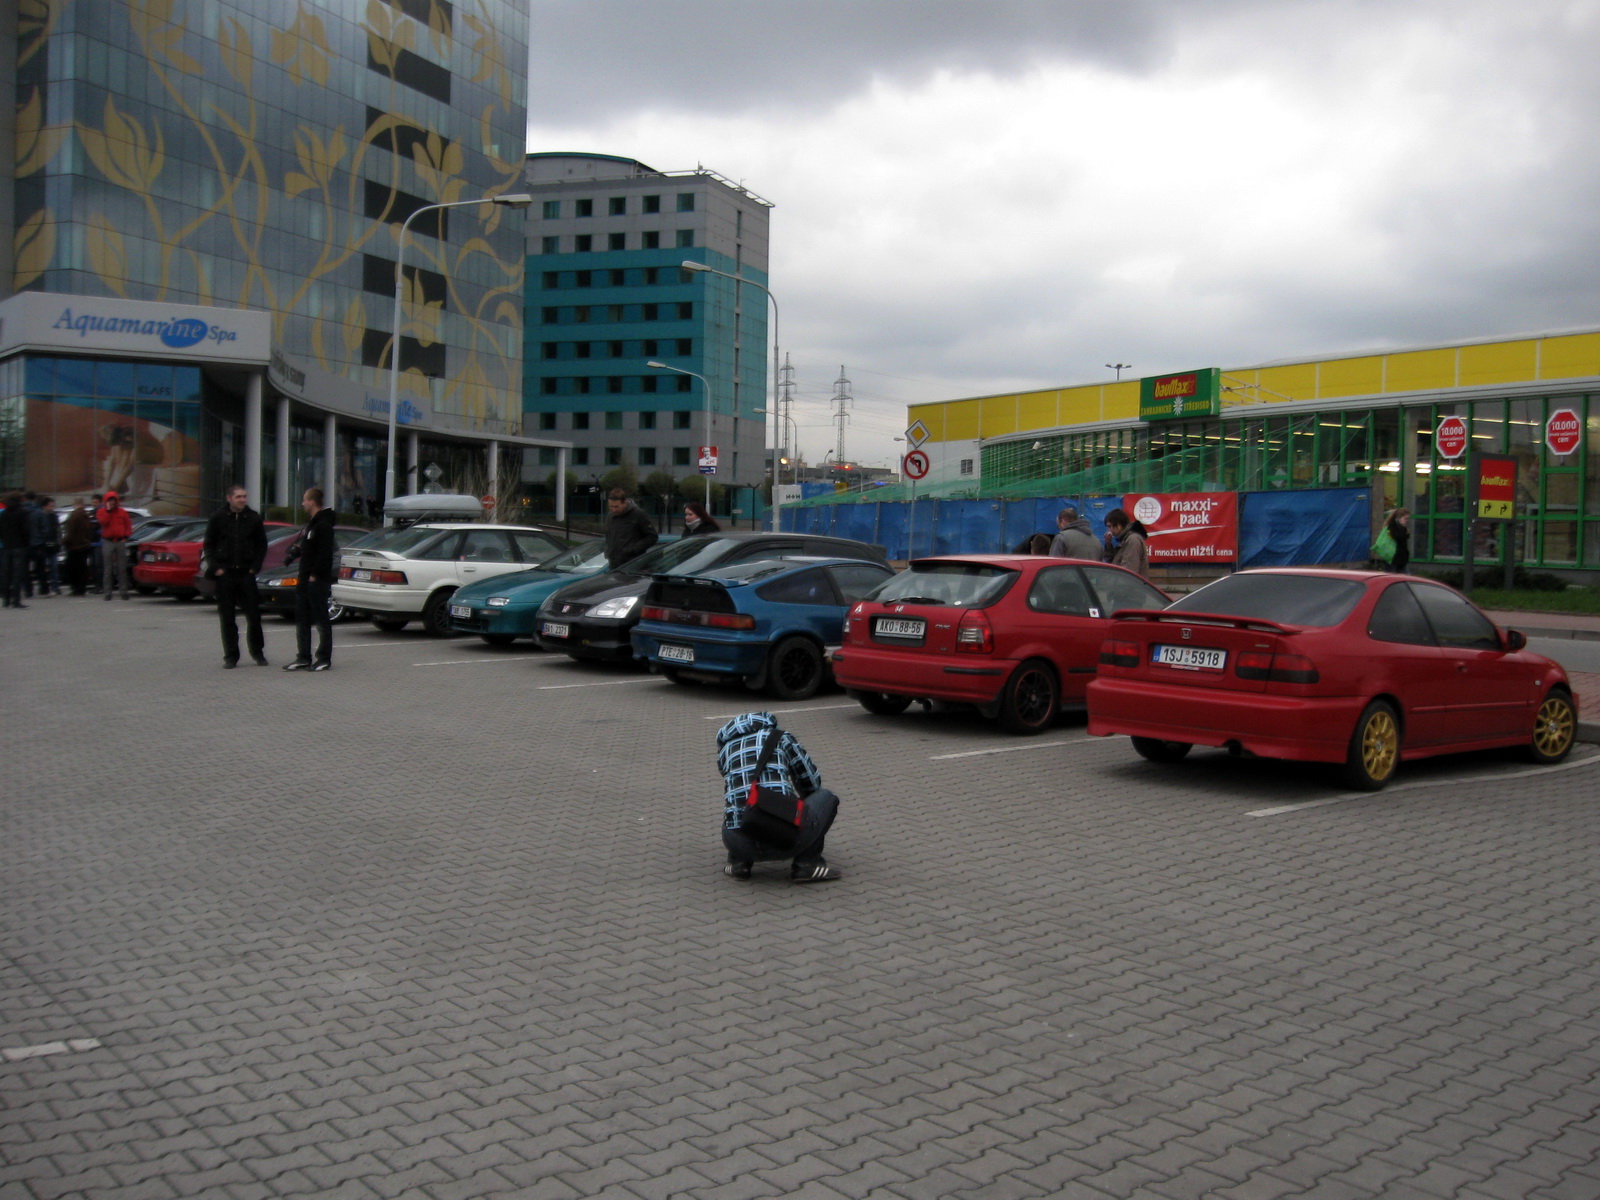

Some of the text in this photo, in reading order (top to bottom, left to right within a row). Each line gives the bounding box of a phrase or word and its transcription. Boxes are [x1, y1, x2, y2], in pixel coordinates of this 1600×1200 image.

[52, 307, 238, 345] Aquamarine Spa
[1441, 426, 1463, 436] 10.000
[1552, 421, 1577, 431] 10.000
[1170, 498, 1218, 512] maxxi-
[1179, 511, 1210, 527] pack
[1154, 548, 1188, 557] množství
[1190, 545, 1214, 557] nižší
[879, 620, 921, 634] AKO 88-56
[661, 646, 673, 656] PTE
[1163, 648, 1220, 666] 1SJ 5918
